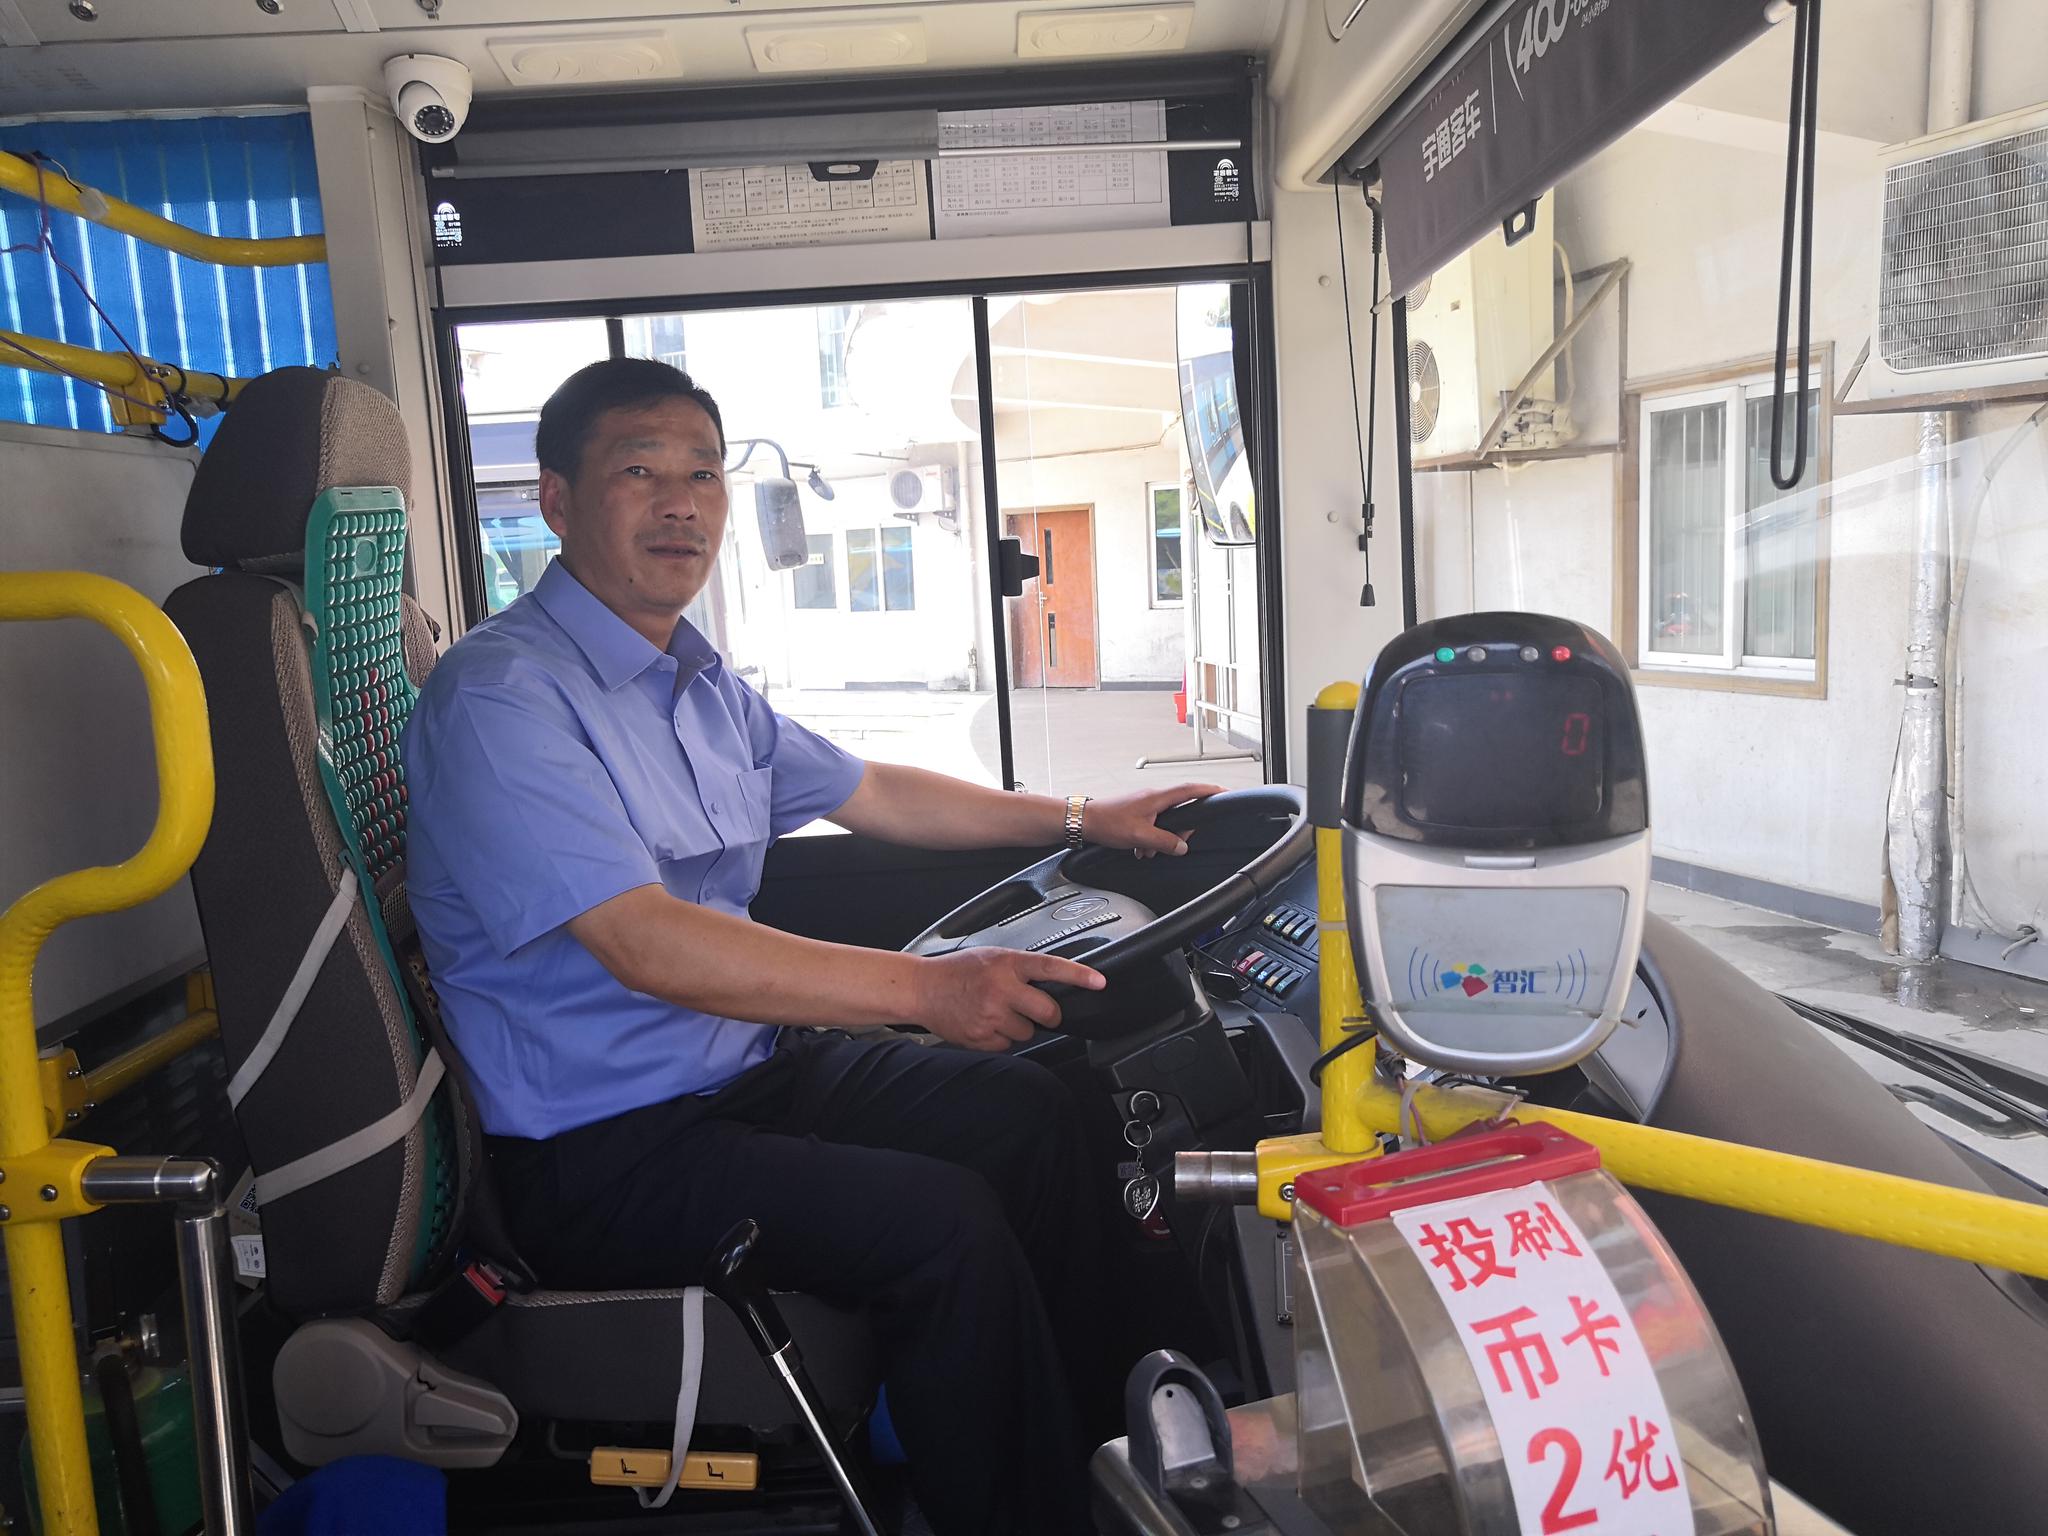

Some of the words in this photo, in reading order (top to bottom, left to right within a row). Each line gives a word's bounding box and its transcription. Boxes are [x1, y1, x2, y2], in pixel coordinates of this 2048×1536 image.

[1422, 88, 1482, 183] 宇通客车
[1561, 712, 1590, 756] 0
[1493, 968, 1548, 996] 智汇
